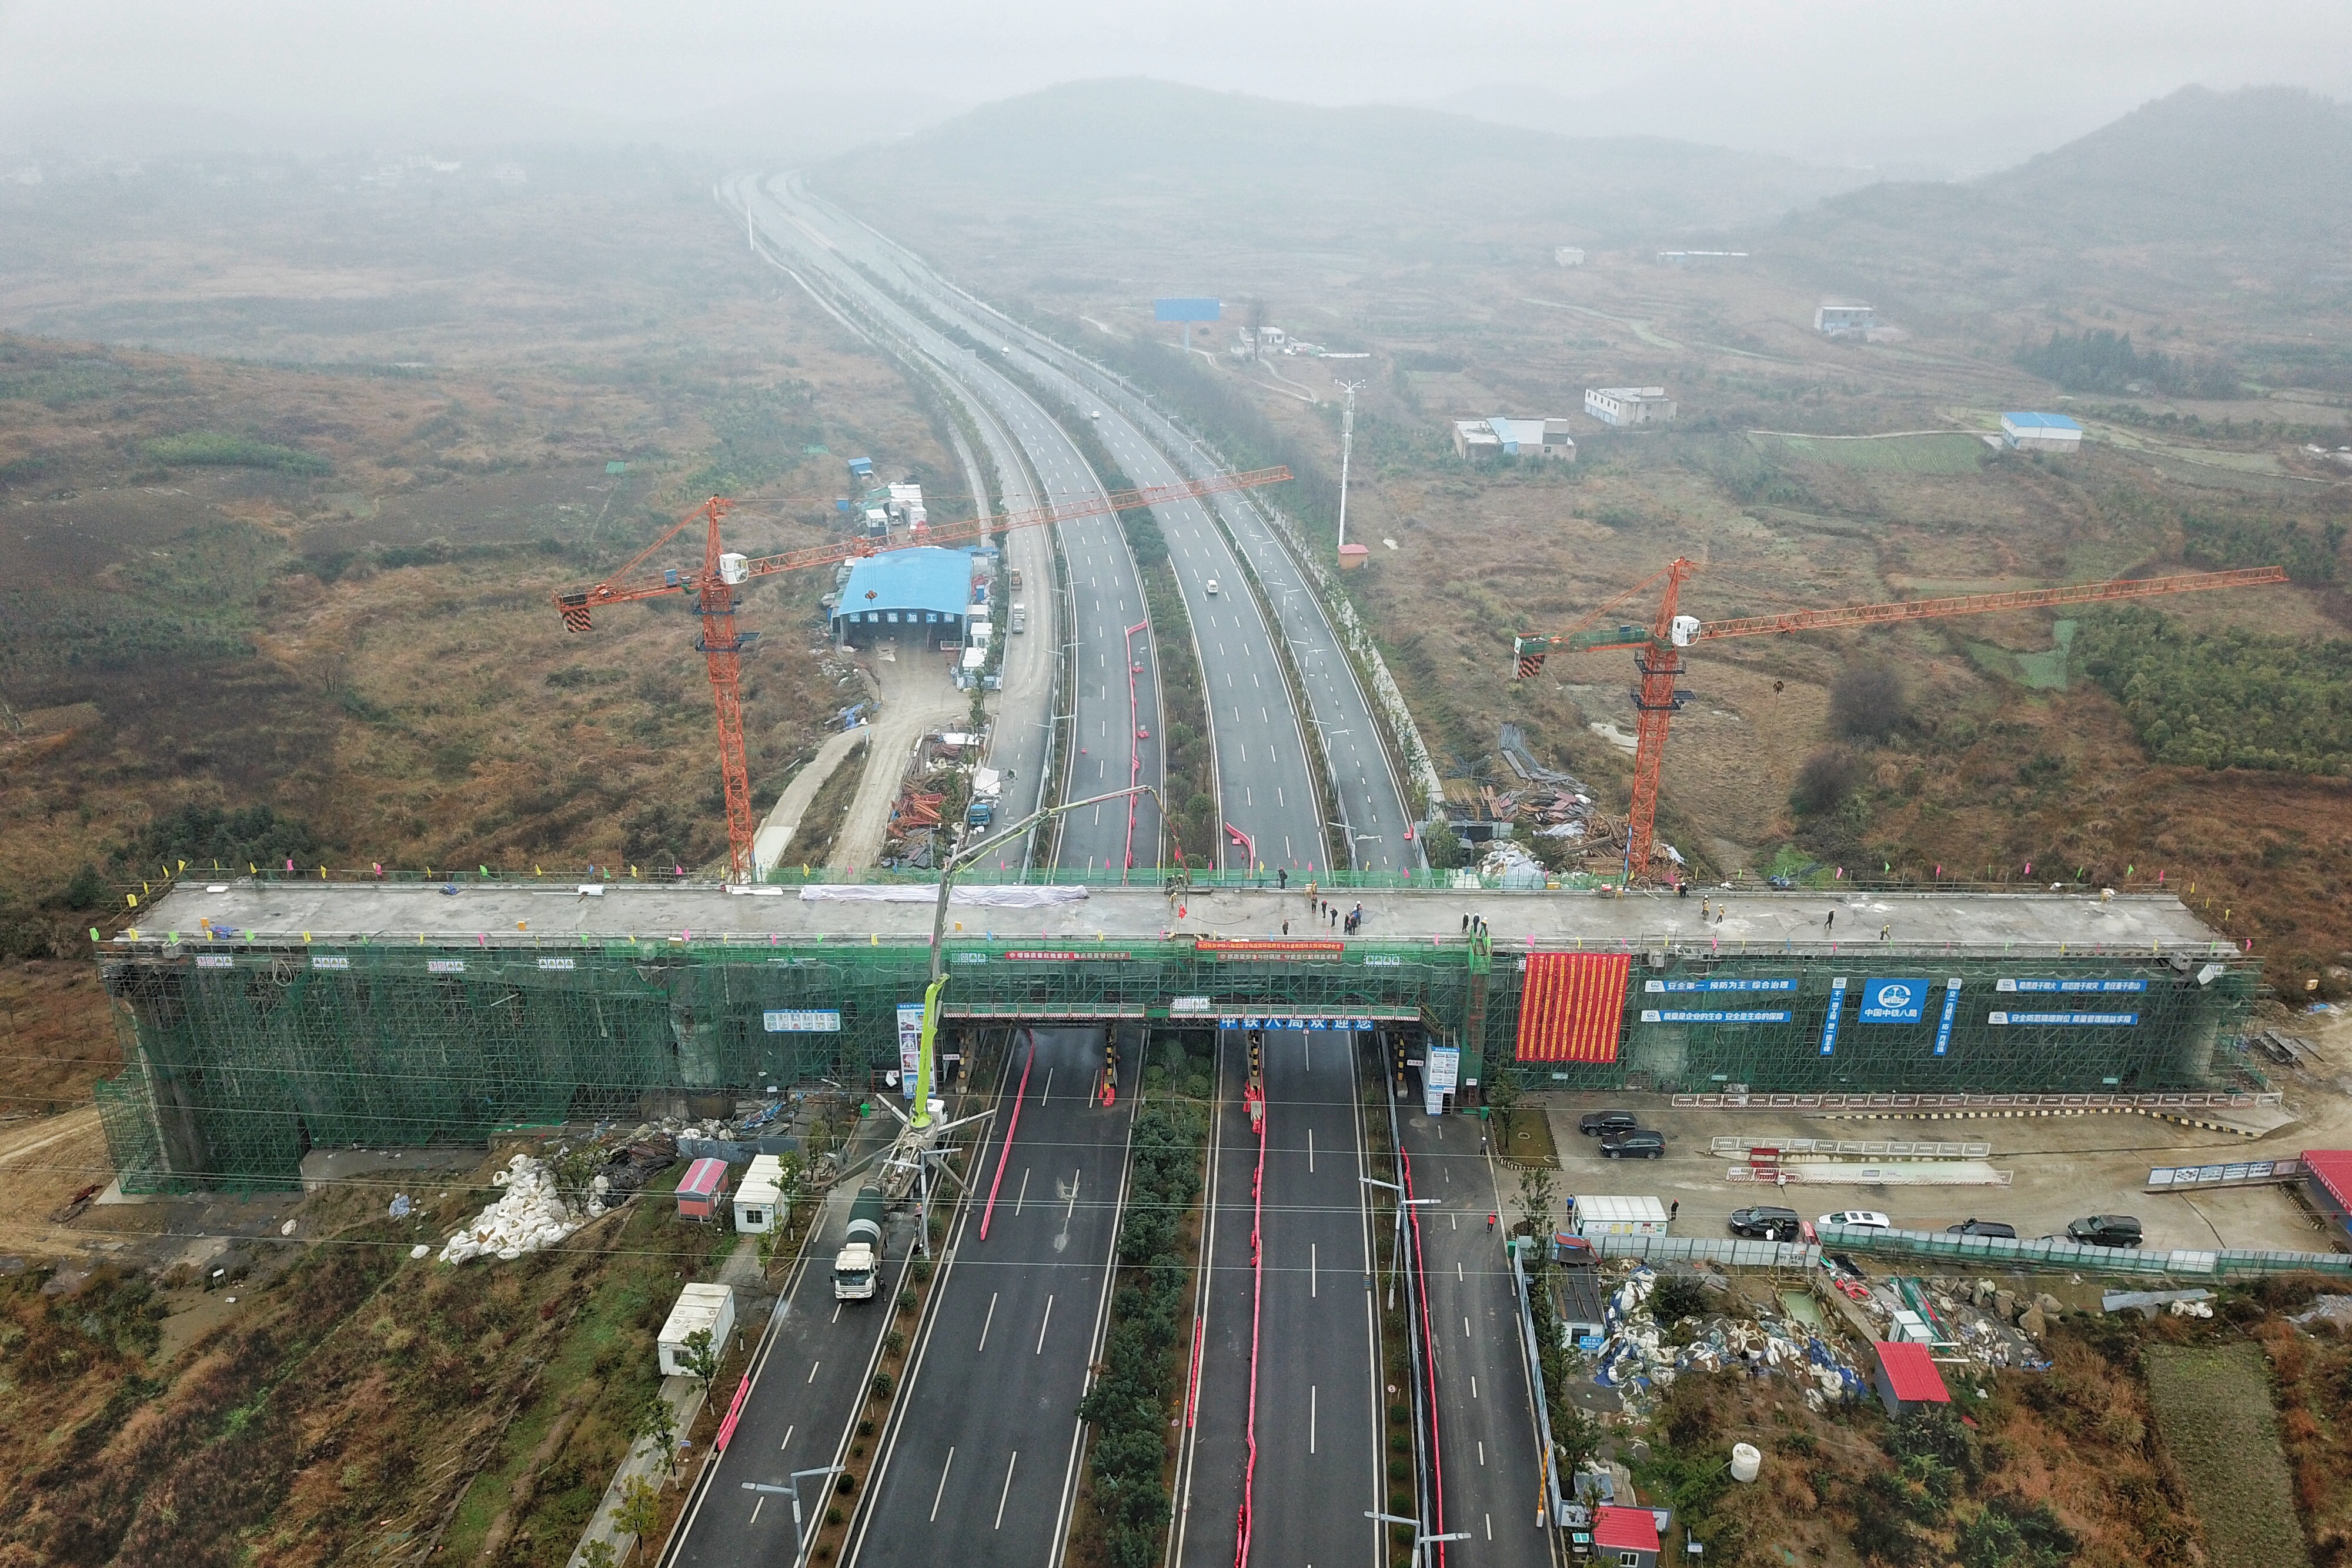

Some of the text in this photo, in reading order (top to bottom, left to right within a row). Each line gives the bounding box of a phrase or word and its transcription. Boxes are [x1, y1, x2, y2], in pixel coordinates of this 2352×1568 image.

[868, 613, 953, 622] 钢筋加工棚
[1667, 981, 1789, 991] 安全第一 预防为主 综合治理
[1663, 1012, 1784, 1021] 质量是企业的生命 安全是生命的保障
[1865, 1008, 1917, 1018] 中国中铁八局
